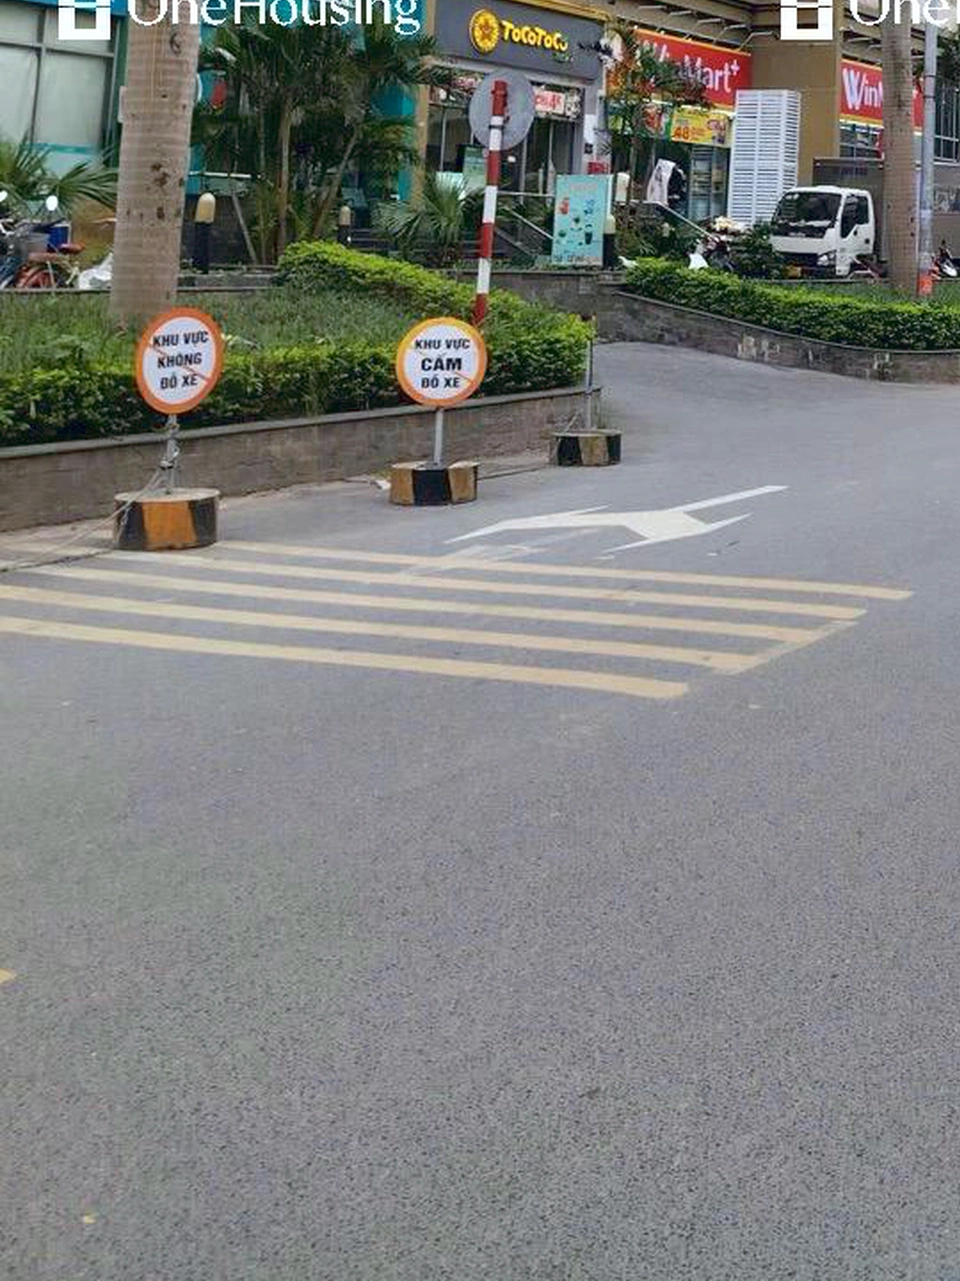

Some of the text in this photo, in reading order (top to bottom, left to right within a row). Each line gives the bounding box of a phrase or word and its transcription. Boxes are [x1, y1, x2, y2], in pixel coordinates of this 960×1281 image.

[153, 333, 179, 347] KHU
[415, 338, 441, 350] KHU
[181, 374, 198, 387] XE
[443, 377, 460, 389] XE
